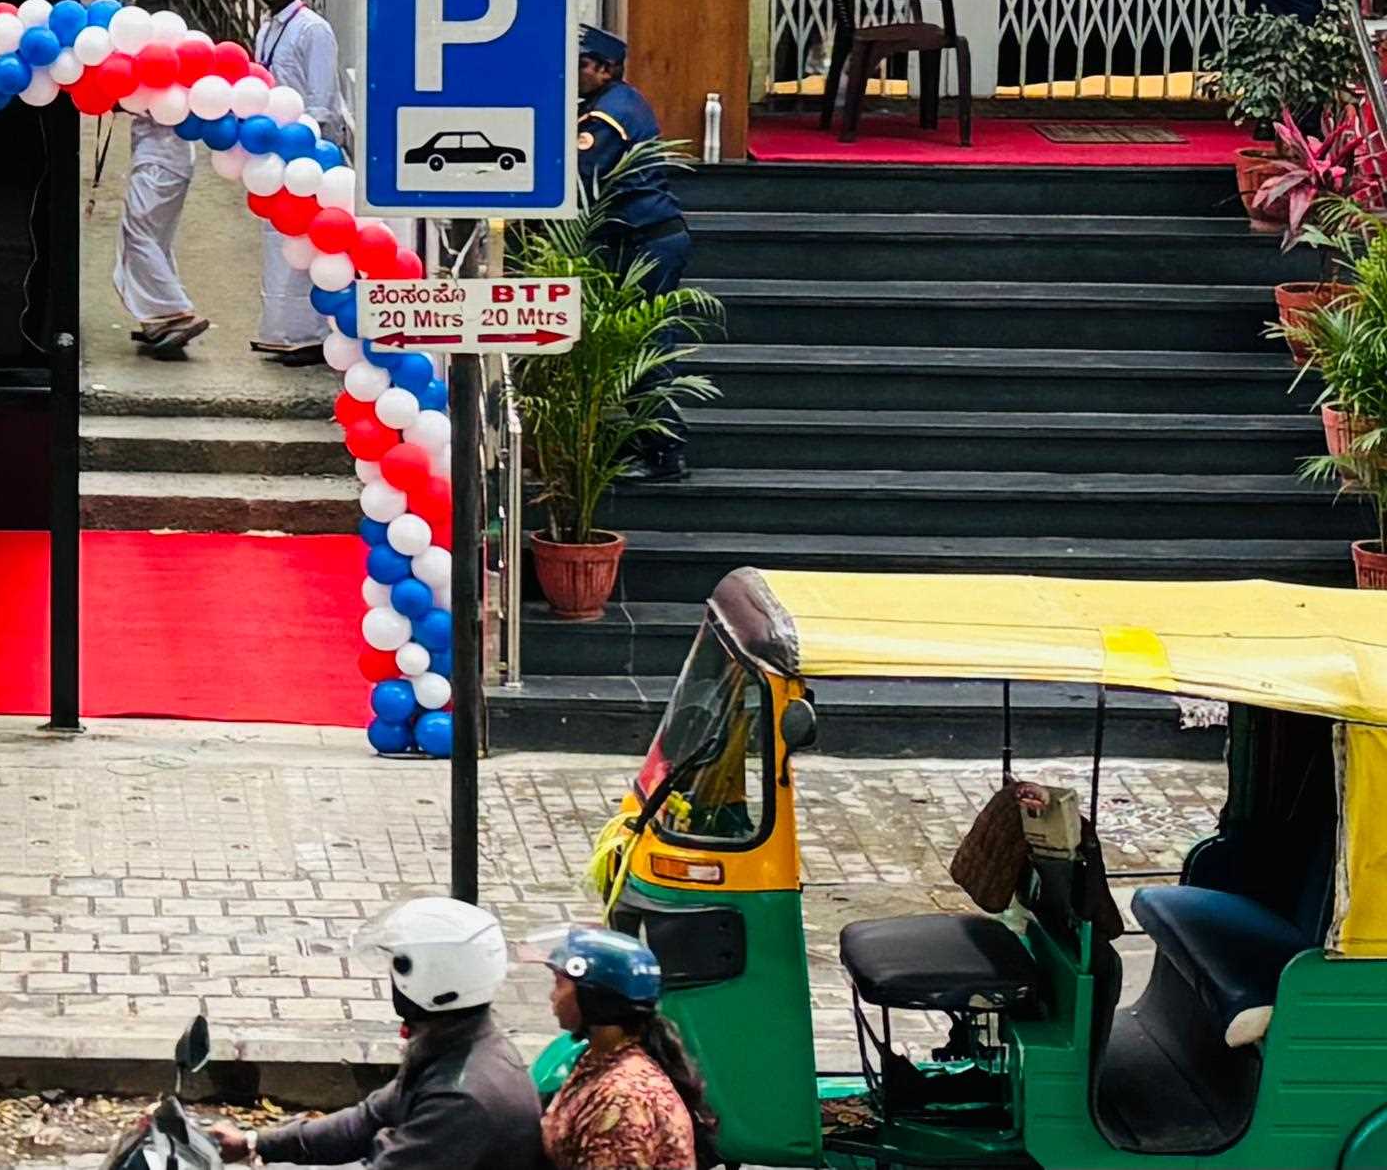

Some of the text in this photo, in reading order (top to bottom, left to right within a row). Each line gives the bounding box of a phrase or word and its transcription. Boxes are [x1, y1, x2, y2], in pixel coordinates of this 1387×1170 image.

[492, 284, 571, 303] BTP
[378, 310, 464, 328] 20 Mtrs
[481, 308, 568, 326] 20 Mtrs
